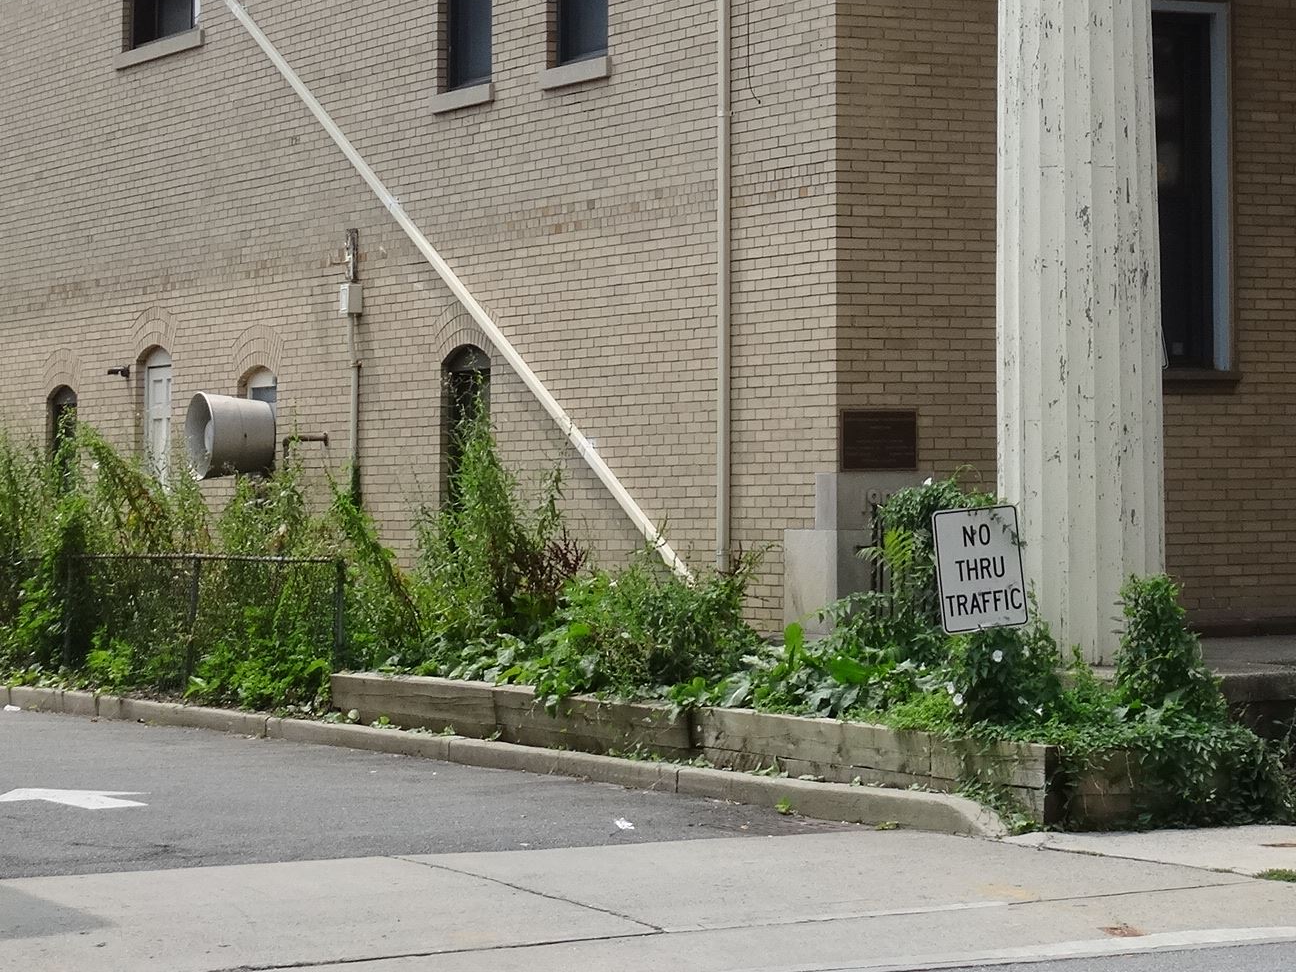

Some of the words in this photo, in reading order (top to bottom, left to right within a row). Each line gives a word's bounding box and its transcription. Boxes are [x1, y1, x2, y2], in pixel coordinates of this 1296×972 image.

[962, 523, 991, 547] NO
[955, 556, 1005, 582] THRU
[946, 588, 1022, 617] TRAFFIC
